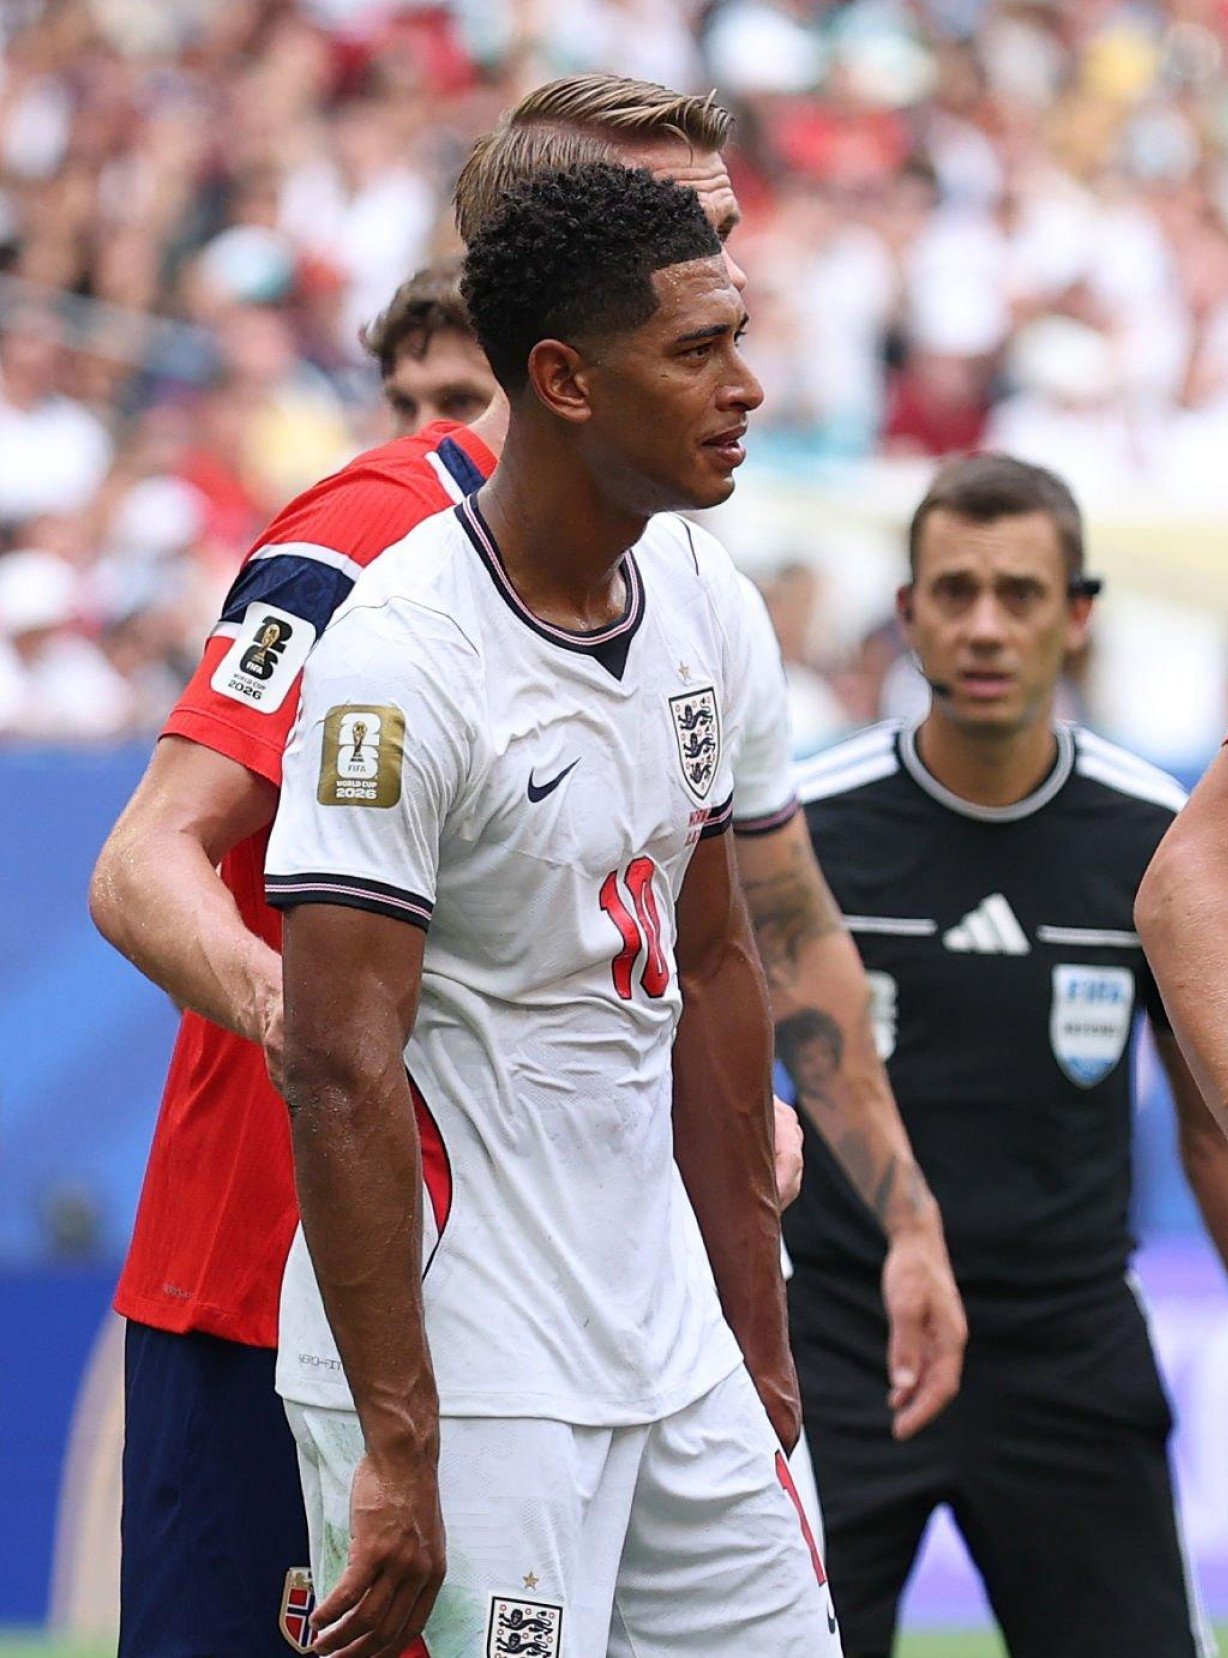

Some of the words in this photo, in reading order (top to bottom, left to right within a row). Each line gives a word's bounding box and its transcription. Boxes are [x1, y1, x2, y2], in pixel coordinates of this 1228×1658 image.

[227, 680, 262, 700] 2026
[347, 765, 367, 773] FIFA
[336, 780, 361, 788] WORLD
[336, 788, 377, 799] 2026
[599, 857, 669, 999] 10
